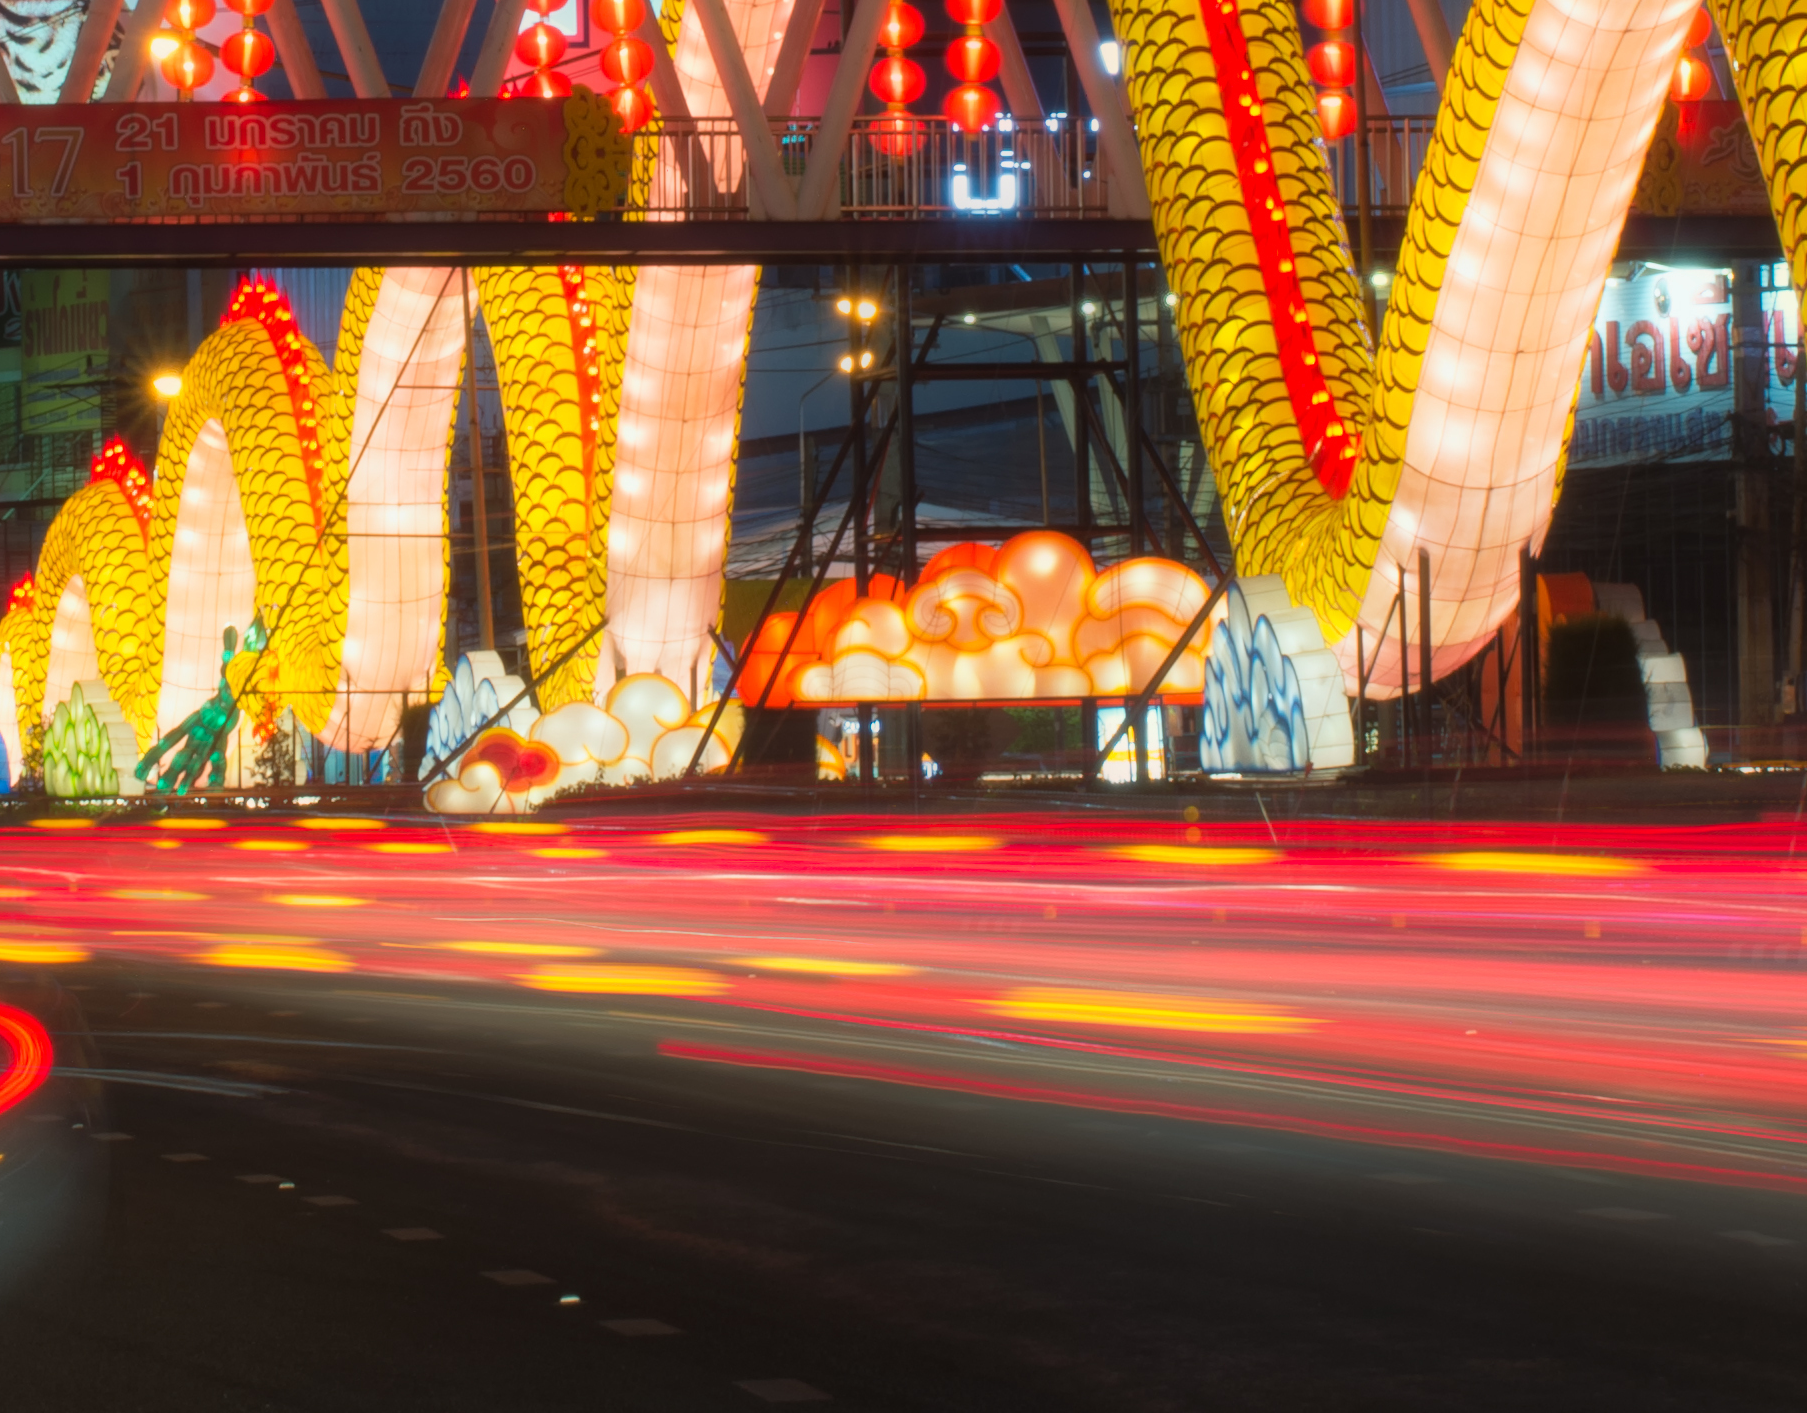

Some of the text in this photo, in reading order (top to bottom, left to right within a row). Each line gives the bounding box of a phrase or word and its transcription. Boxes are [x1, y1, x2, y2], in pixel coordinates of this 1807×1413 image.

[115, 101, 464, 152] 21 มกราคม ถึง
[115, 151, 537, 209] 1 กุมภาพันธ์ 2560
